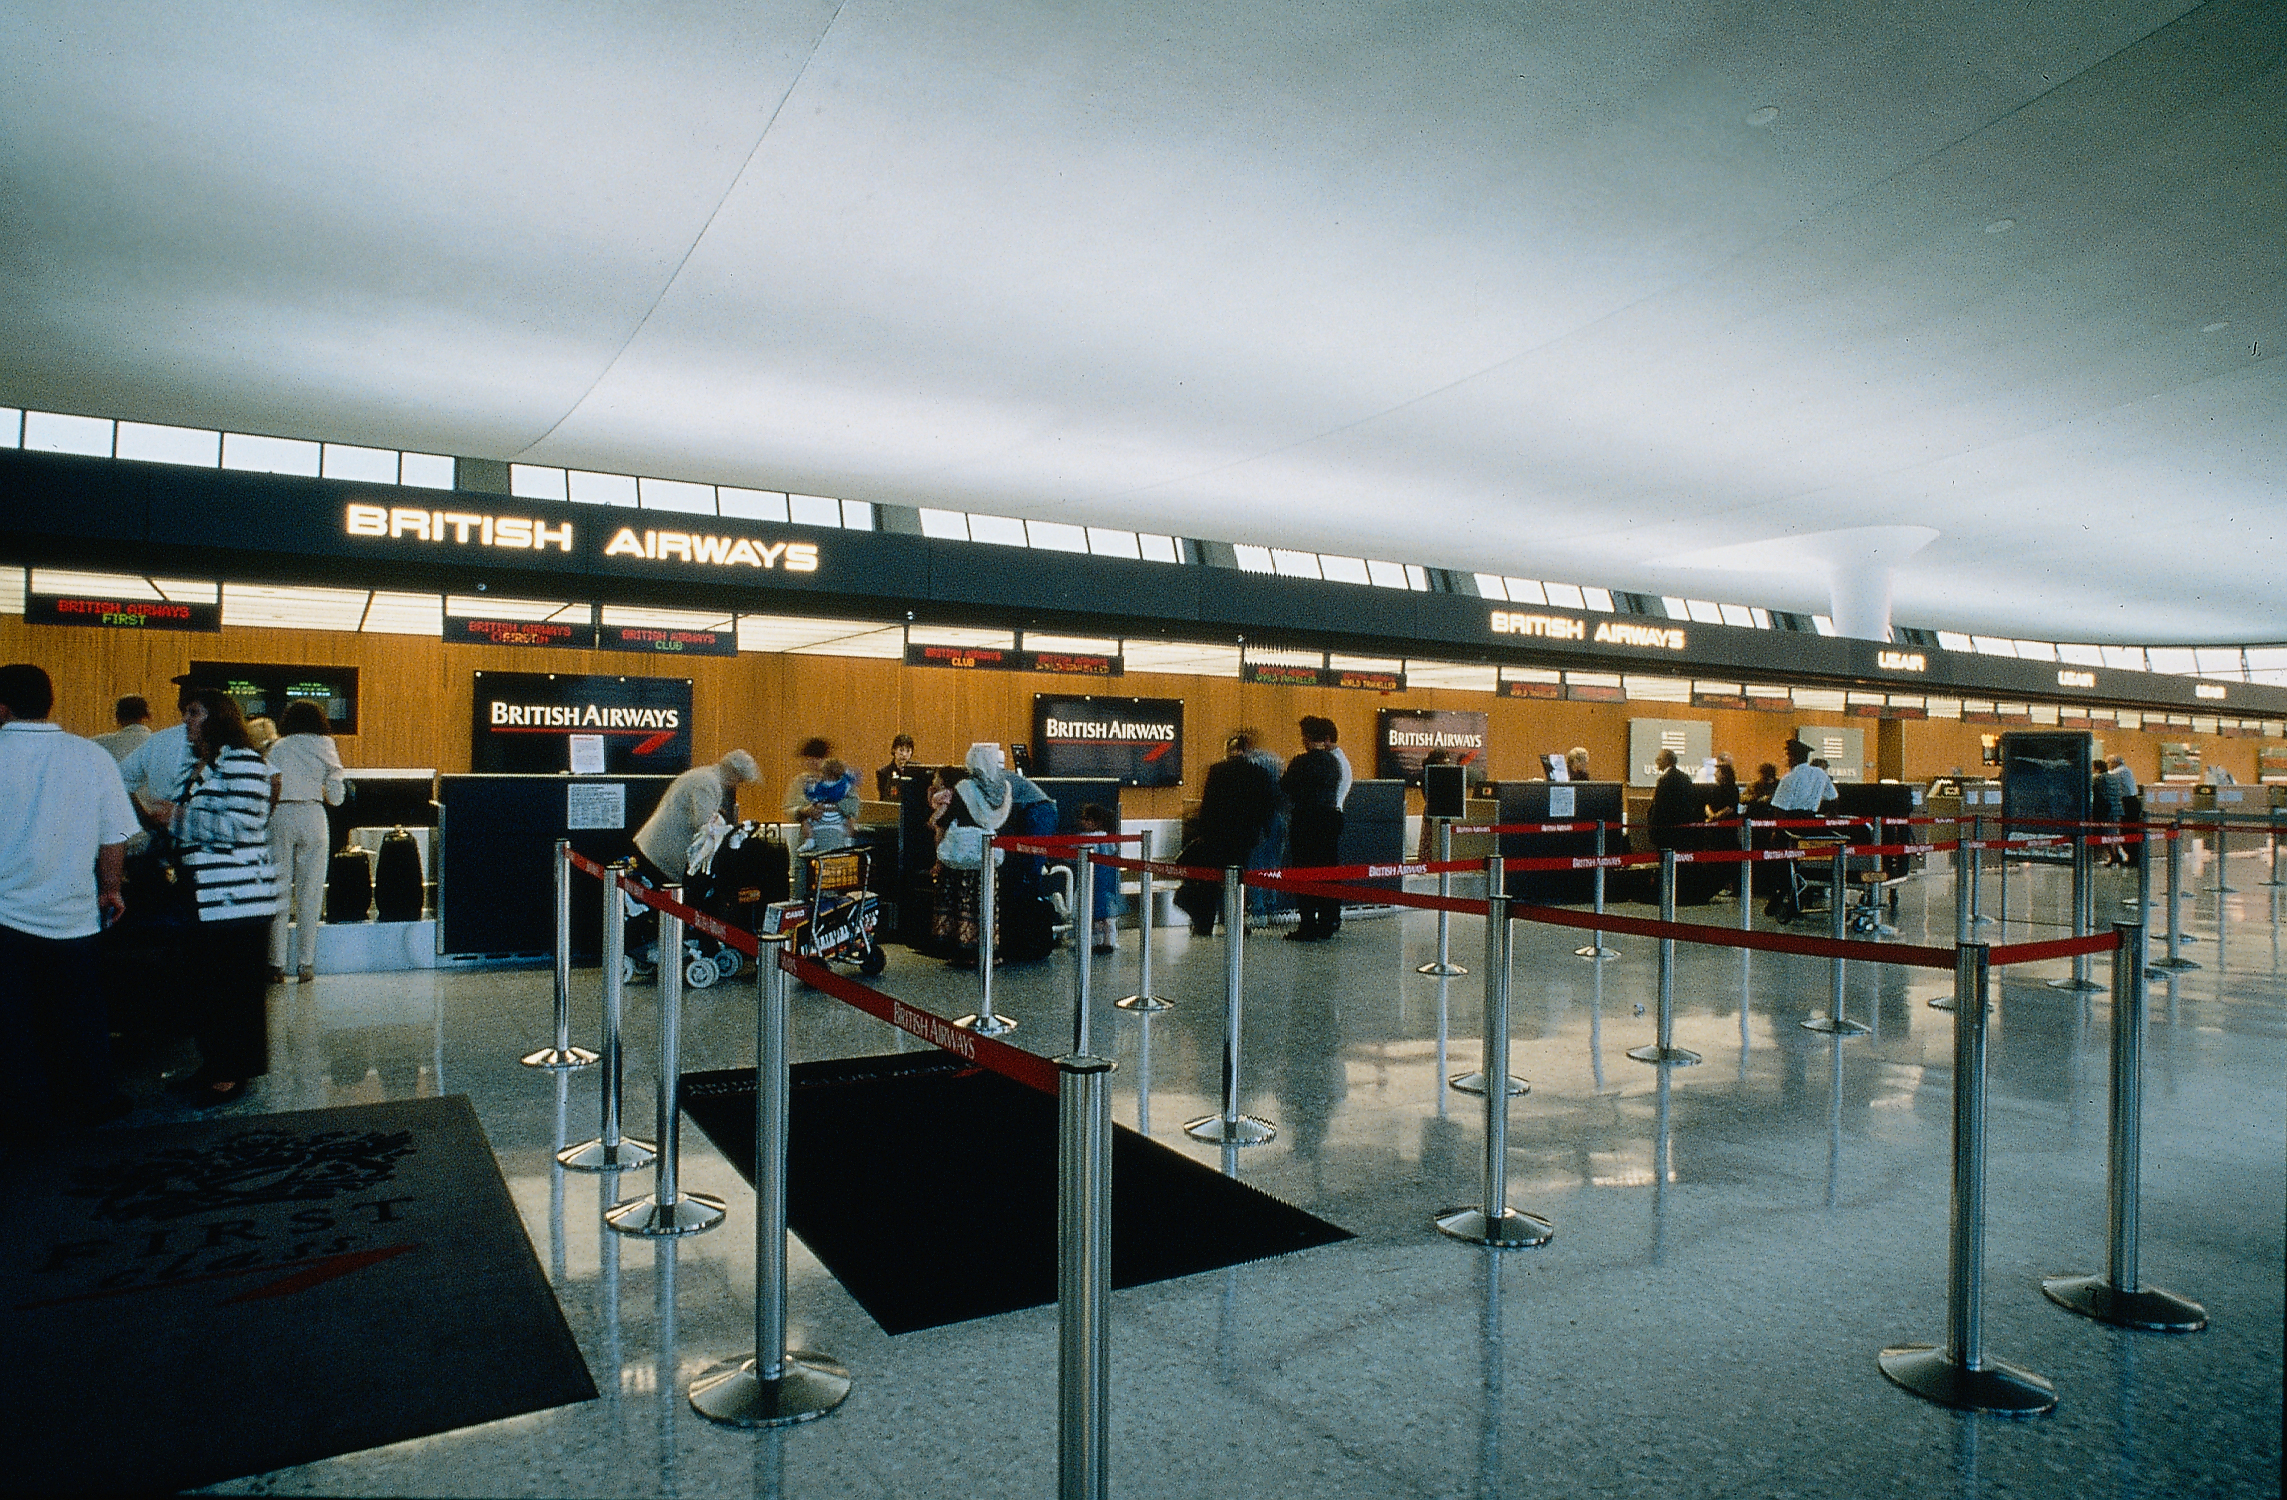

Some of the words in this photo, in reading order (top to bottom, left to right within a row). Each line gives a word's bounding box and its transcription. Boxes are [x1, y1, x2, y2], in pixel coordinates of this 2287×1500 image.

[346, 503, 572, 552] BRITISH
[604, 526, 818, 572] AIRWAYS
[58, 599, 121, 614] BRITISH
[126, 602, 190, 619] AIRWAYS
[102, 613, 147, 626] FIRST
[468, 620, 518, 633] BRITISH
[522, 624, 572, 637] AIRWAYS
[621, 628, 667, 641] BRITISH
[670, 631, 716, 644] AIRWAYS
[1490, 610, 1585, 640] BRITISH
[1594, 621, 1686, 650] AIRWAYS
[655, 640, 683, 651] CLUB
[952, 657, 975, 668] CLUB
[1877, 650, 1926, 672] USAIR
[491, 701, 580, 726] BRITISH
[581, 704, 679, 729] AIRWAYS
[1046, 718, 1107, 738] BRITISH
[1108, 720, 1175, 741] AIRWAYS
[1389, 729, 1434, 747] BRITISH
[1434, 731, 1482, 748] AIRWAYS
[1369, 865, 1396, 877] BRITISH
[1397, 864, 1427, 876] AIRWAYS
[893, 1001, 928, 1041] BRITISH
[929, 1017, 976, 1060] AIRWAYS
[40, 1196, 416, 1273] FIRST
